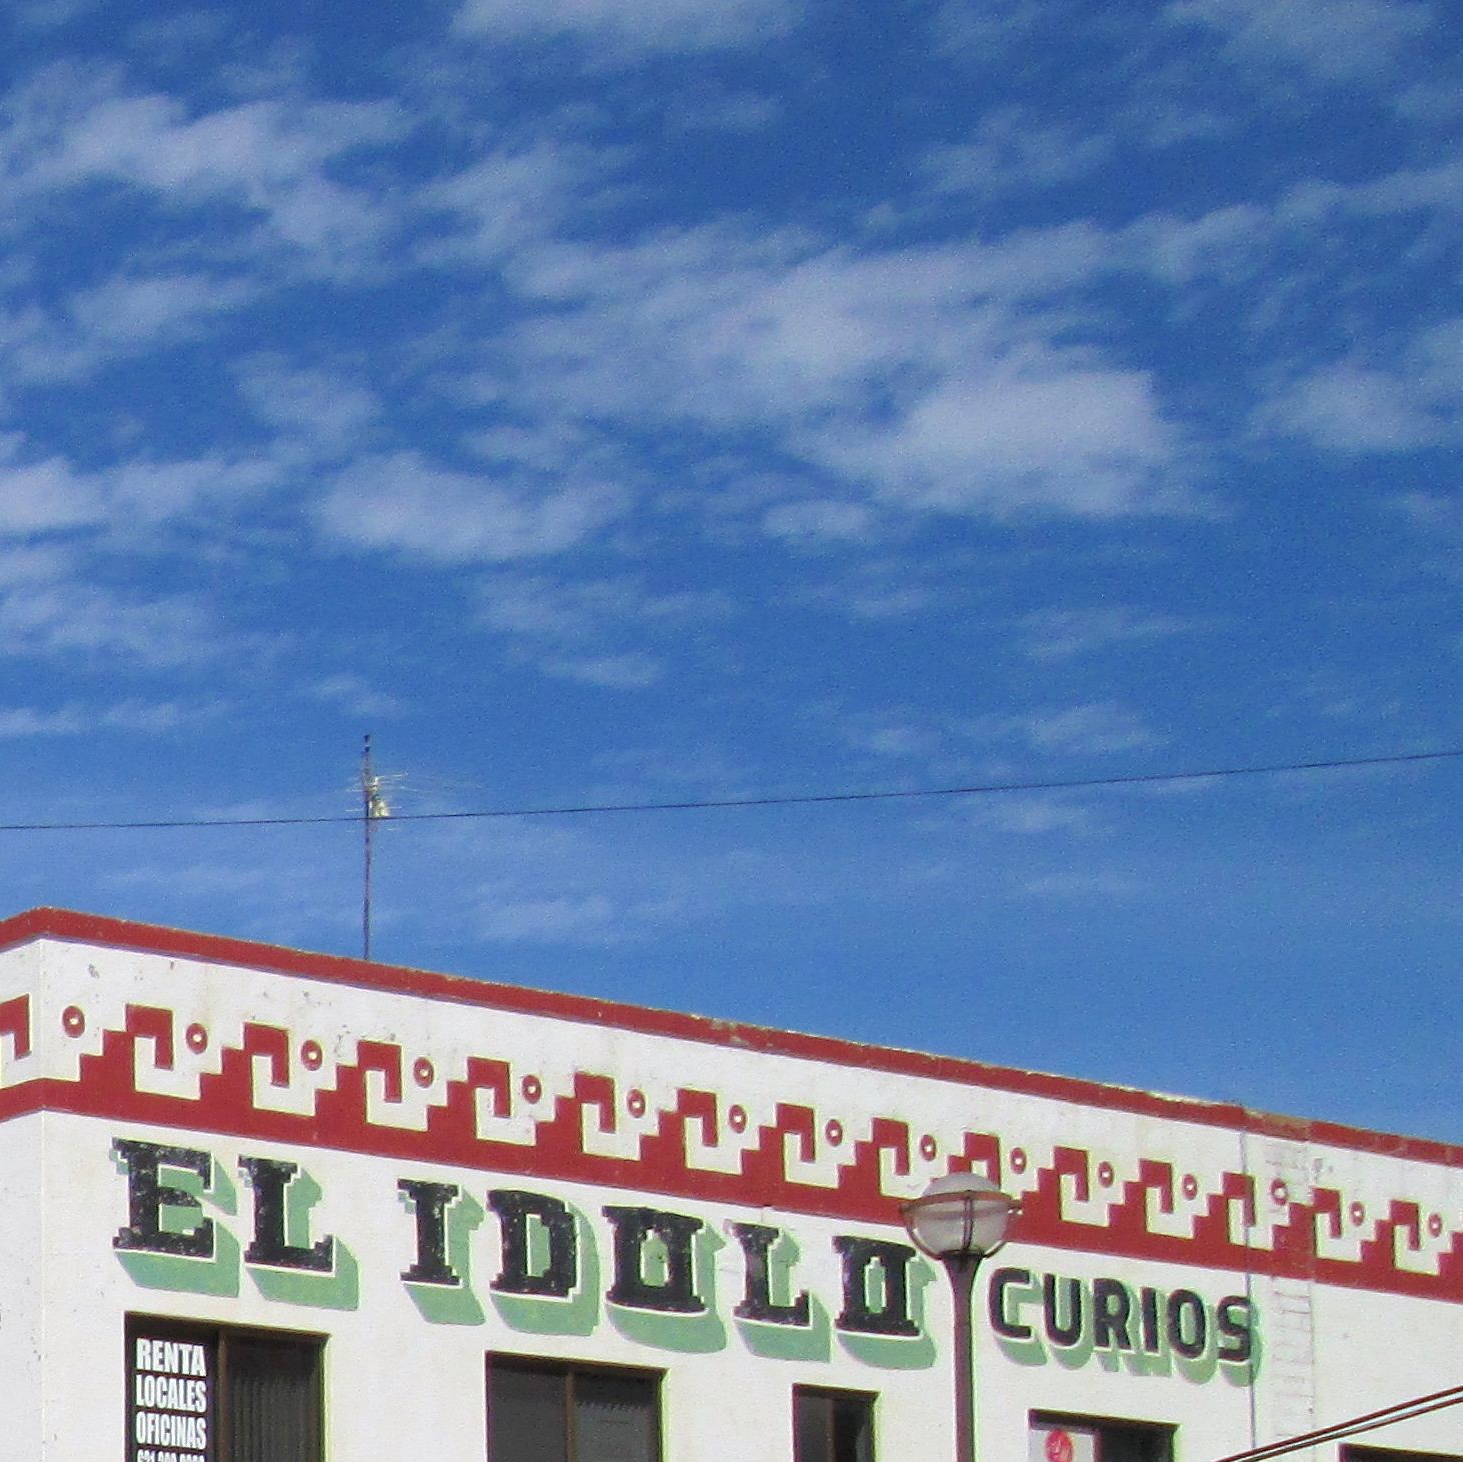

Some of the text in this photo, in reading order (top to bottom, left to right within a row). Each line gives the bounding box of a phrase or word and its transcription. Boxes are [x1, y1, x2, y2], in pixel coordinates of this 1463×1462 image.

[111, 1137, 1259, 1377] EL IDOLO CURIOS
[136, 1338, 207, 1377] RENTA
[136, 1374, 207, 1413] LOCALES
[136, 1411, 207, 1450] OFICINAS
